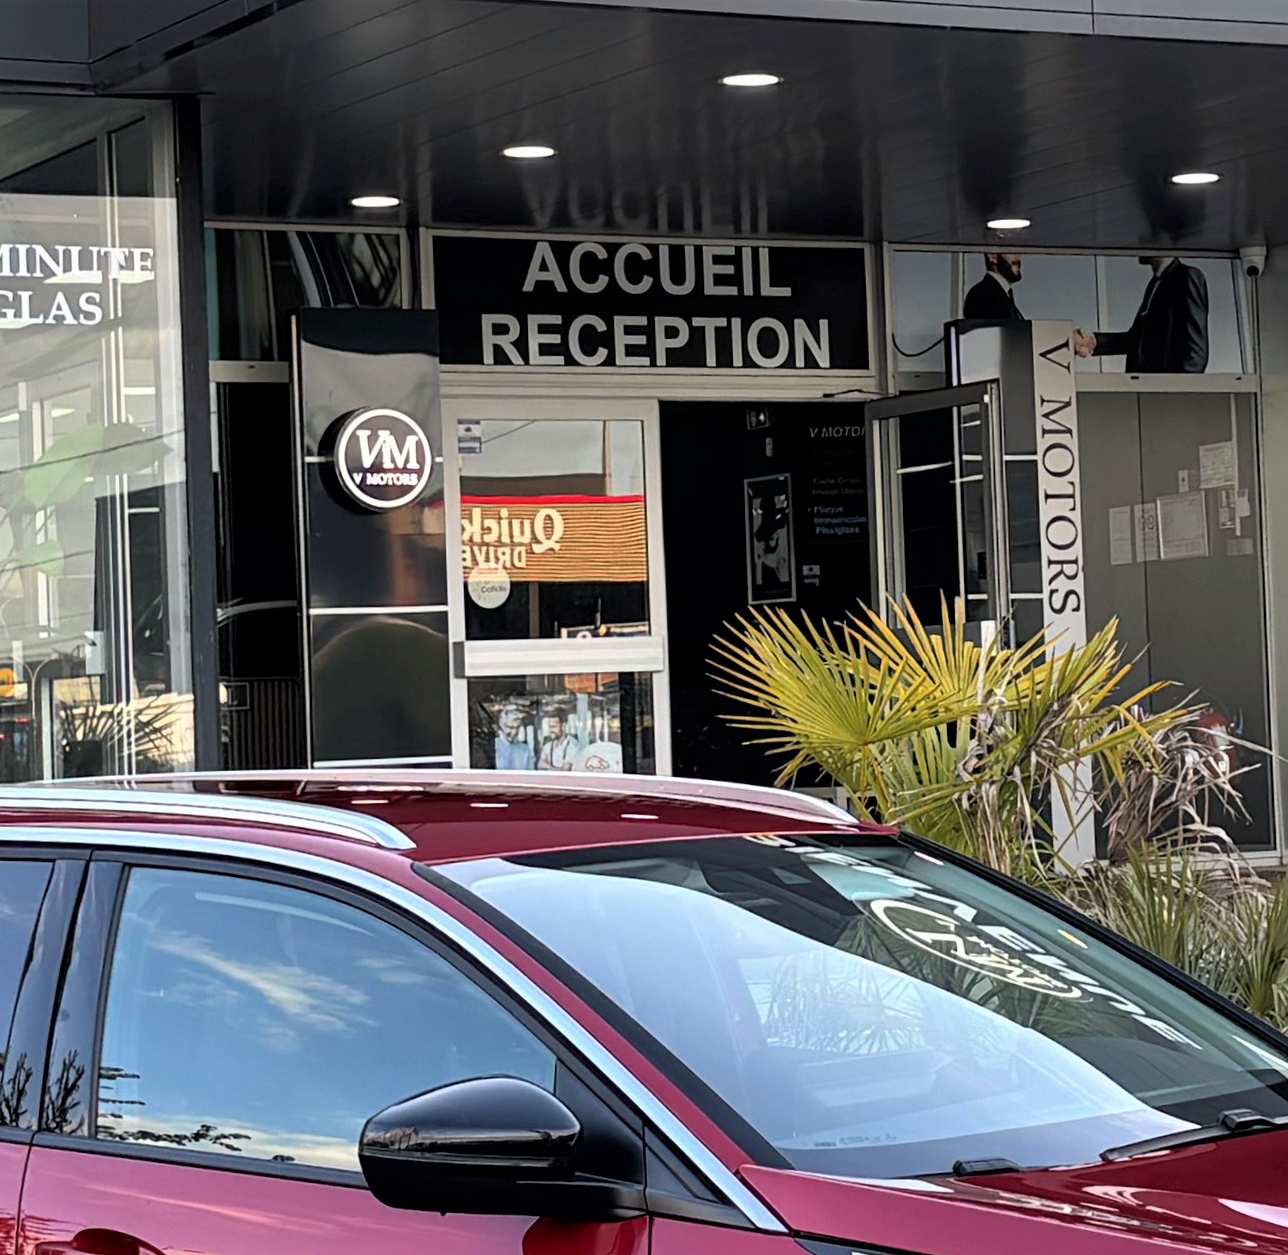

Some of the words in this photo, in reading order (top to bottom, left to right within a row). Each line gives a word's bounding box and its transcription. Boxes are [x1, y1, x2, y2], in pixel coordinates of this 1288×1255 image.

[522, 241, 792, 297] ACCUEIL
[481, 313, 831, 369] RECEPTION
[1038, 338, 1072, 375] V
[355, 429, 420, 470] VM
[352, 472, 363, 486] V
[366, 472, 419, 487] MOTORS
[1039, 394, 1082, 615] MOTORS
